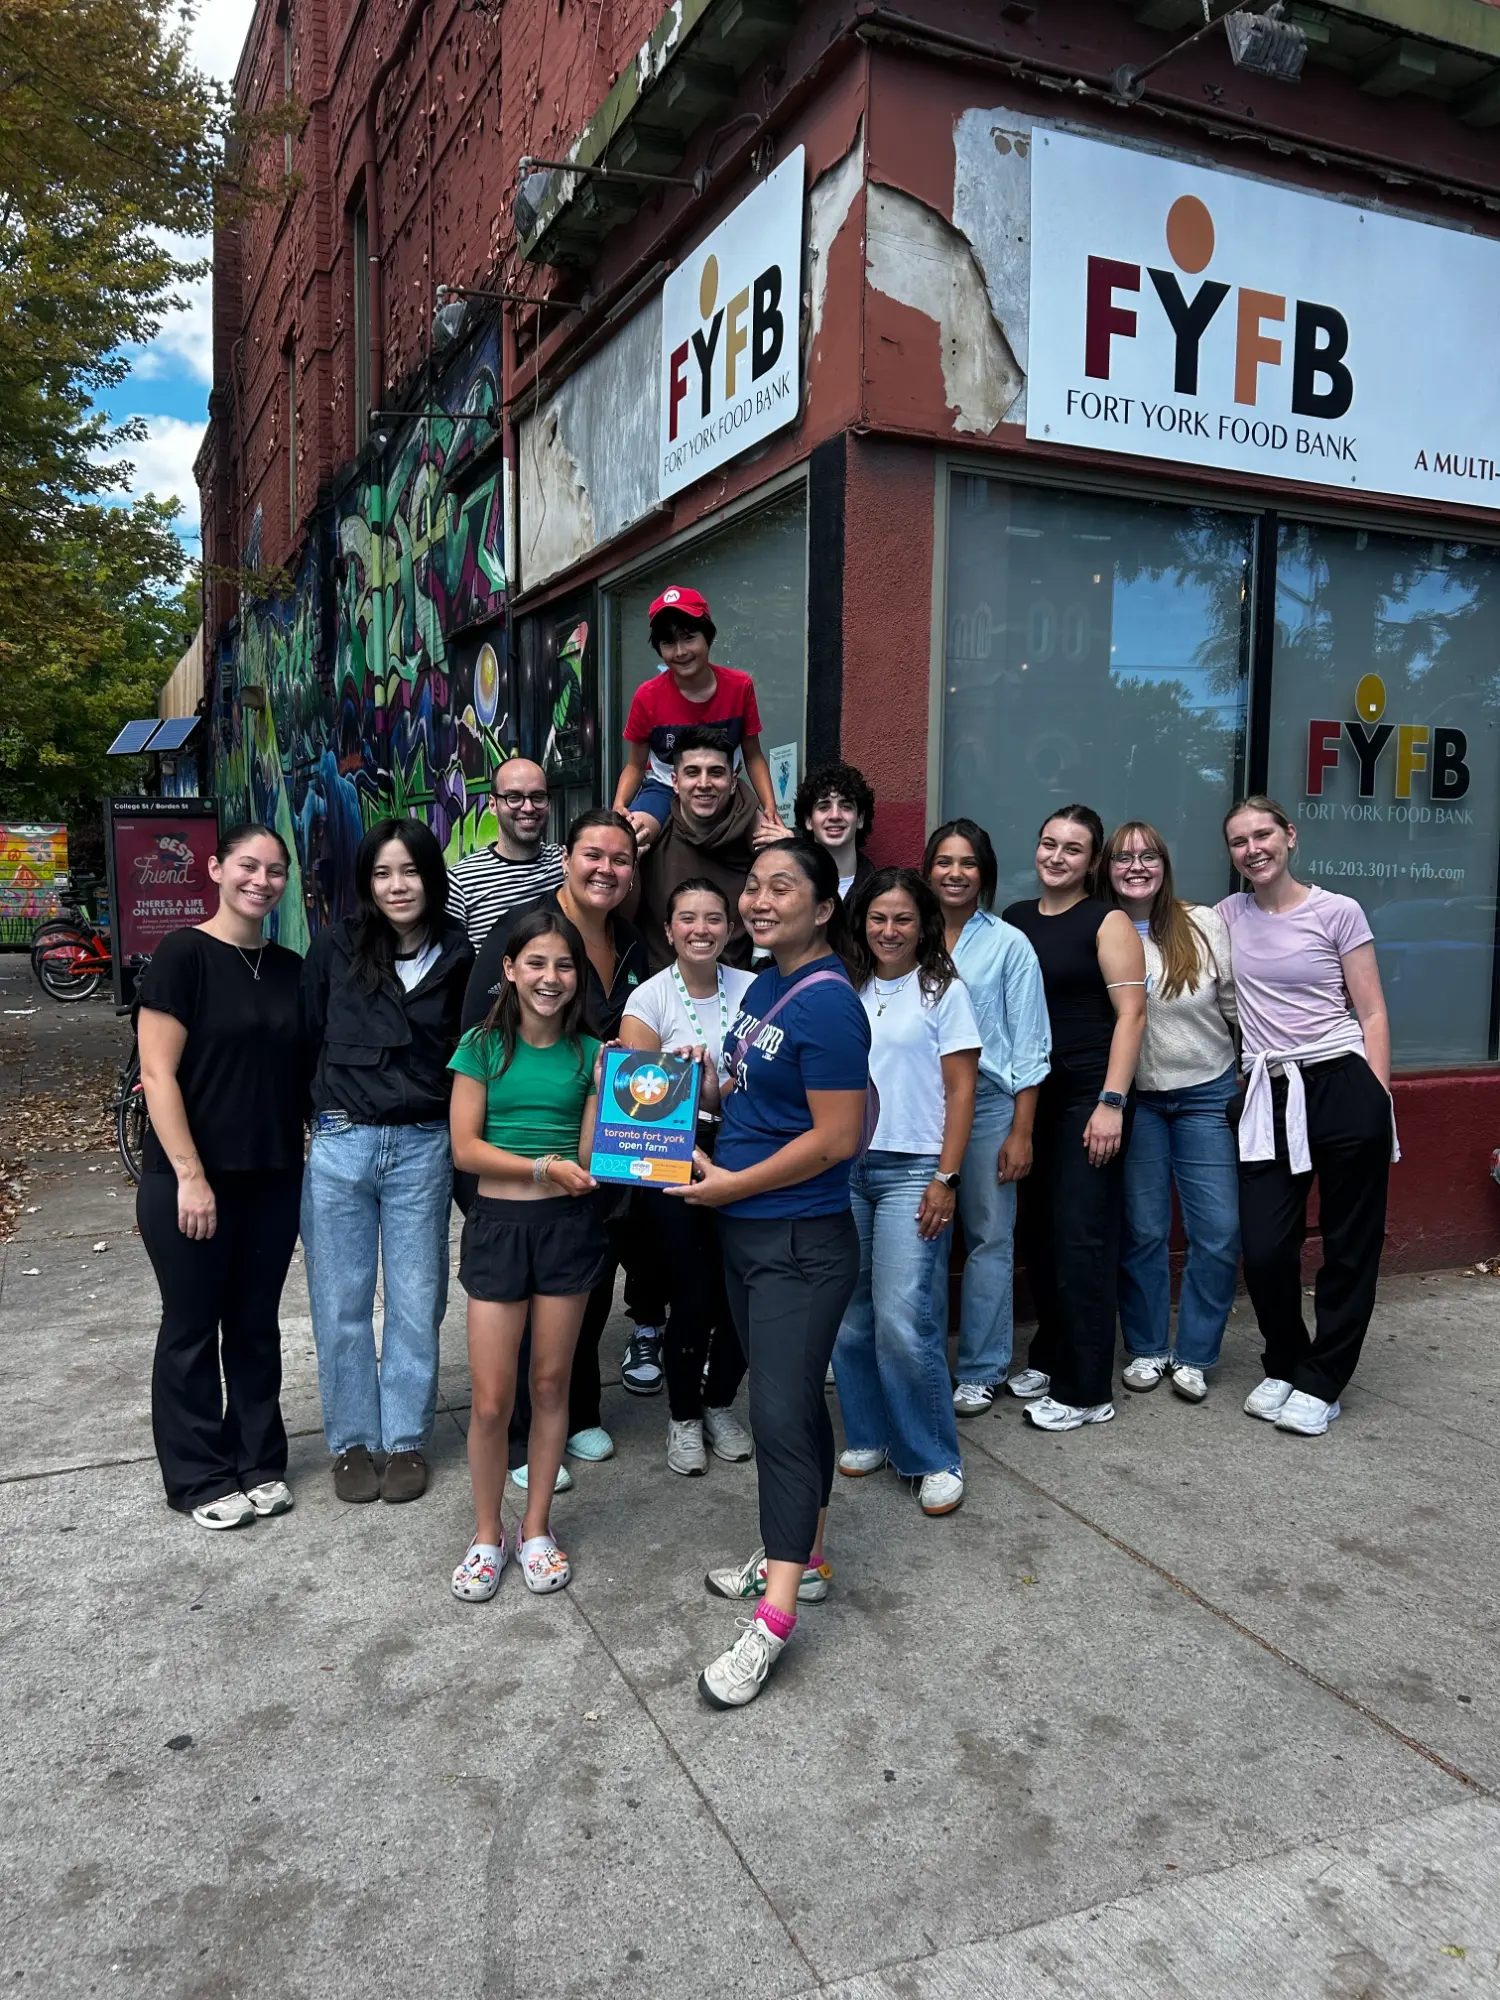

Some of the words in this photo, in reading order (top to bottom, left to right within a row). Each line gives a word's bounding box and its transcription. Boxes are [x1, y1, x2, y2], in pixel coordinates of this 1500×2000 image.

[1085, 254, 1354, 420] FYFB
[669, 264, 784, 443] FYFB
[664, 443, 688, 476] FORT
[689, 422, 716, 458] YORK
[718, 398, 753, 440] FOOD
[756, 371, 790, 414] BANK
[1067, 389, 1135, 424] FORT
[1141, 401, 1210, 438] YORK
[1219, 415, 1288, 450] FOOD
[1296, 428, 1358, 462] BANK
[1414, 449, 1428, 471] A
[1433, 452, 1500, 481] MULTI-
[1306, 719, 1471, 801] FYFB
[1297, 802, 1339, 820] FORT
[1341, 803, 1384, 822] YORK
[1388, 806, 1431, 824] FOOD
[1435, 807, 1475, 825] BANK
[159, 836, 195, 861] BEST
[134, 855, 196, 885] Friend
[1308, 859, 1398, 878] 416.203.3011
[1409, 862, 1465, 883] fyfb.com
[132, 908, 149, 916] ON
[152, 907, 182, 916] EVERY
[184, 907, 208, 915] BIKE.
[136, 899, 174, 908] THERE'S
[176, 899, 184, 907] A
[186, 899, 204, 907] LIFE
[604, 1128, 641, 1139] toronto
[643, 1131, 661, 1141] fort
[663, 1135, 685, 1144] york
[618, 1141, 643, 1151] open
[645, 1142, 668, 1153] farm
[594, 1157, 628, 1173] 2025
